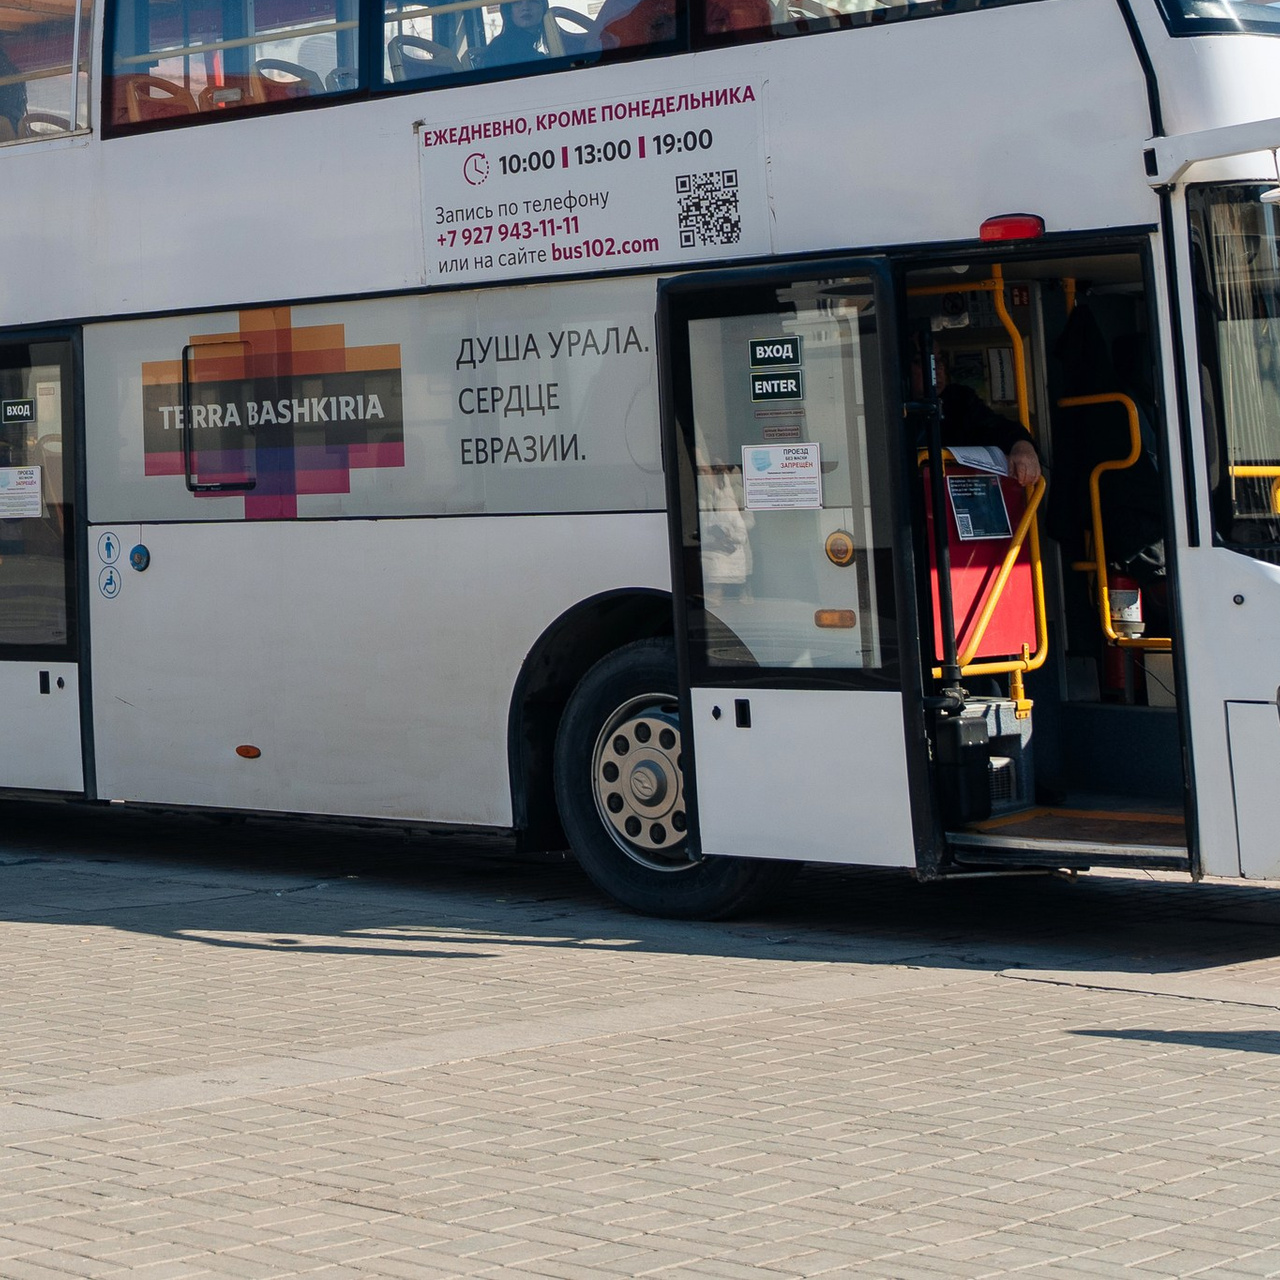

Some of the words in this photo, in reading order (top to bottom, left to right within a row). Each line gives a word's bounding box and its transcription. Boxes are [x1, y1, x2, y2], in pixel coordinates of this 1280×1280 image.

[424, 117, 532, 147] ЕЖЕДНЕВНО,
[536, 107, 597, 131] КРОМЕ
[601, 85, 755, 121] ПОНЕДЕЛЬНИКА
[499, 149, 555, 175] 10:00
[574, 139, 631, 165] 13:00
[652, 129, 713, 155] 19:00
[435, 205, 493, 224] Запись
[498, 202, 519, 218] по
[523, 190, 609, 215] телефону
[437, 230, 457, 247] +7
[461, 226, 493, 246] 927
[498, 216, 580, 242] 943-11-11
[438, 258, 469, 273] или
[474, 255, 493, 269] на
[498, 247, 547, 267] сайте
[551, 236, 660, 262] bus102.com
[456, 333, 541, 371] ДУША
[547, 325, 650, 360] УРАЛА.
[755, 344, 793, 359] ВХОД
[458, 382, 560, 417] СЕРДЦЕ
[755, 379, 797, 394] ENTER
[6, 404, 31, 417] ВХОД
[159, 403, 241, 430] TERRA
[247, 395, 385, 426] BASHKIRIA
[460, 433, 587, 465] ЕВРАЗИИ.
